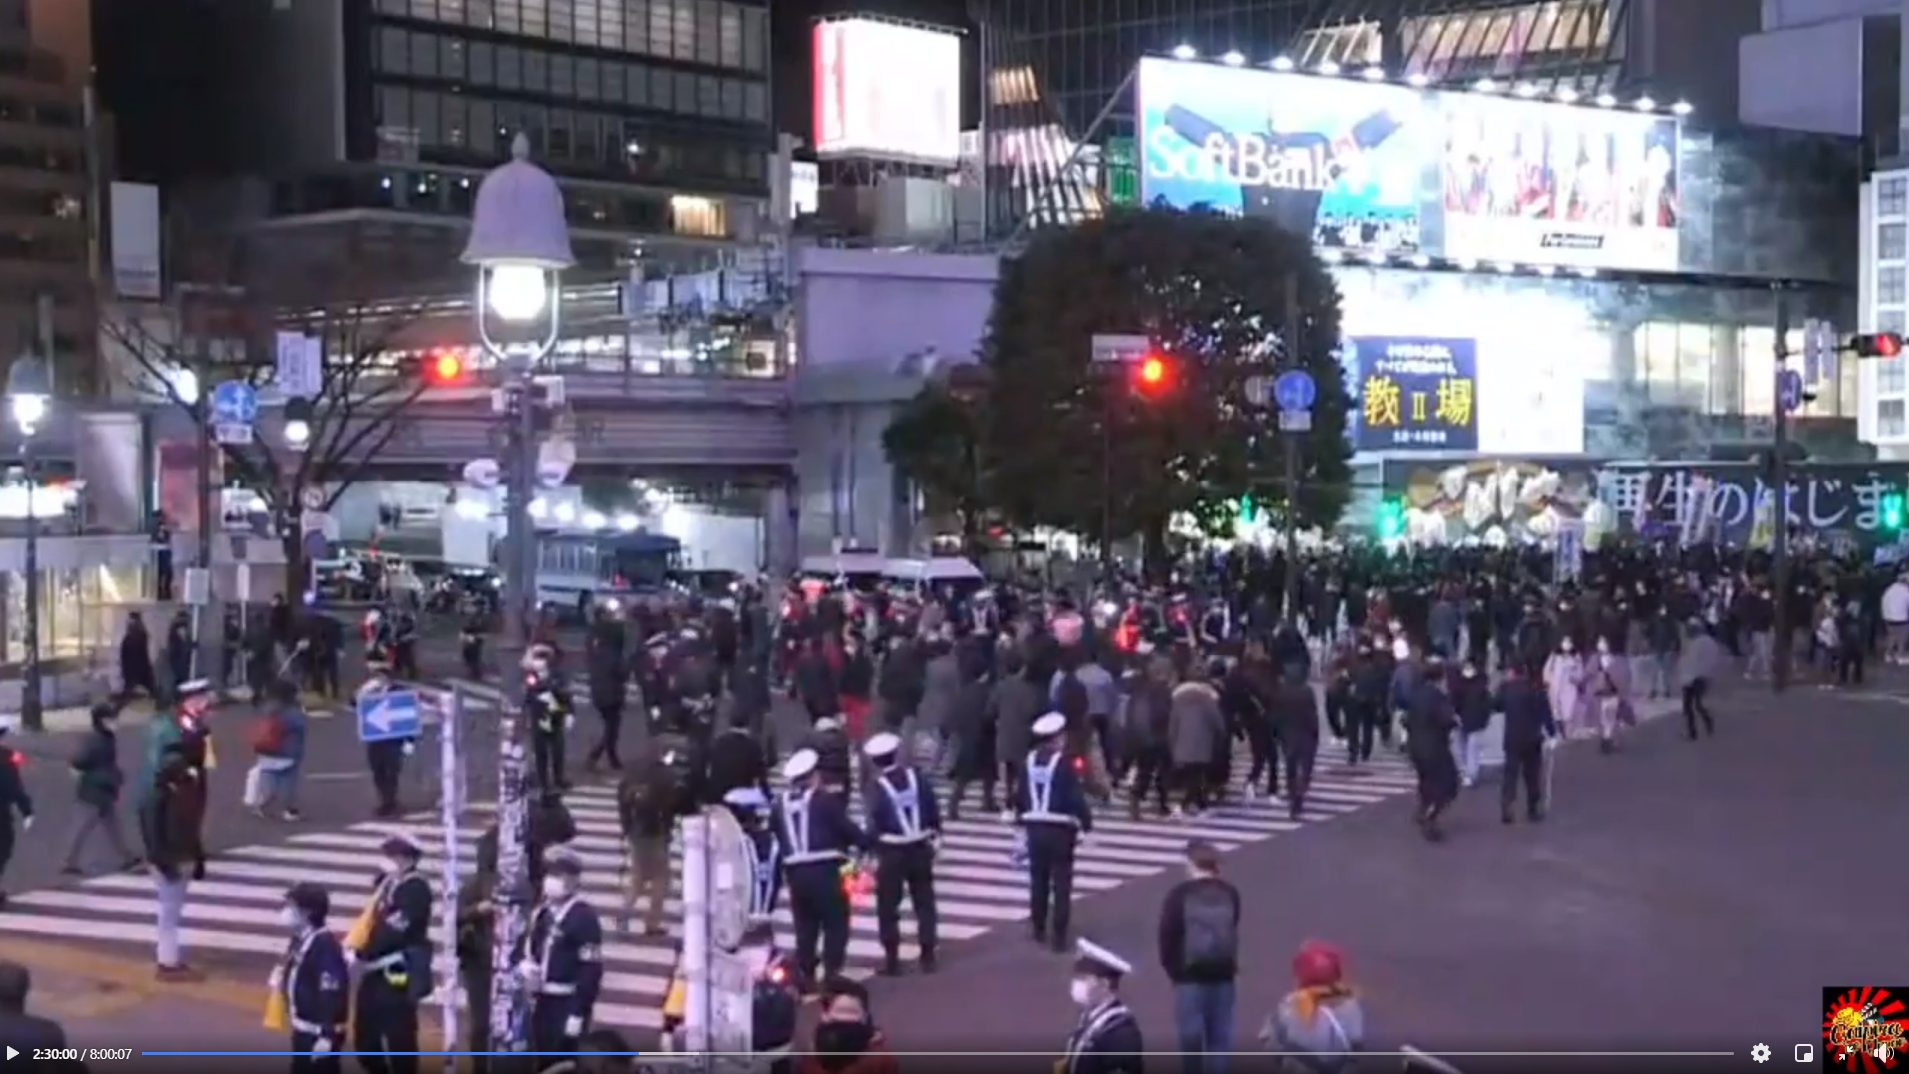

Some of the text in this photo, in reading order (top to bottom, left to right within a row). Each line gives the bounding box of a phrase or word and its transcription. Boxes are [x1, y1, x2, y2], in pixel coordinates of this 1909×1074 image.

[1149, 124, 1336, 190] SoftBank
[1606, 471, 1909, 530] 再生のはじま
